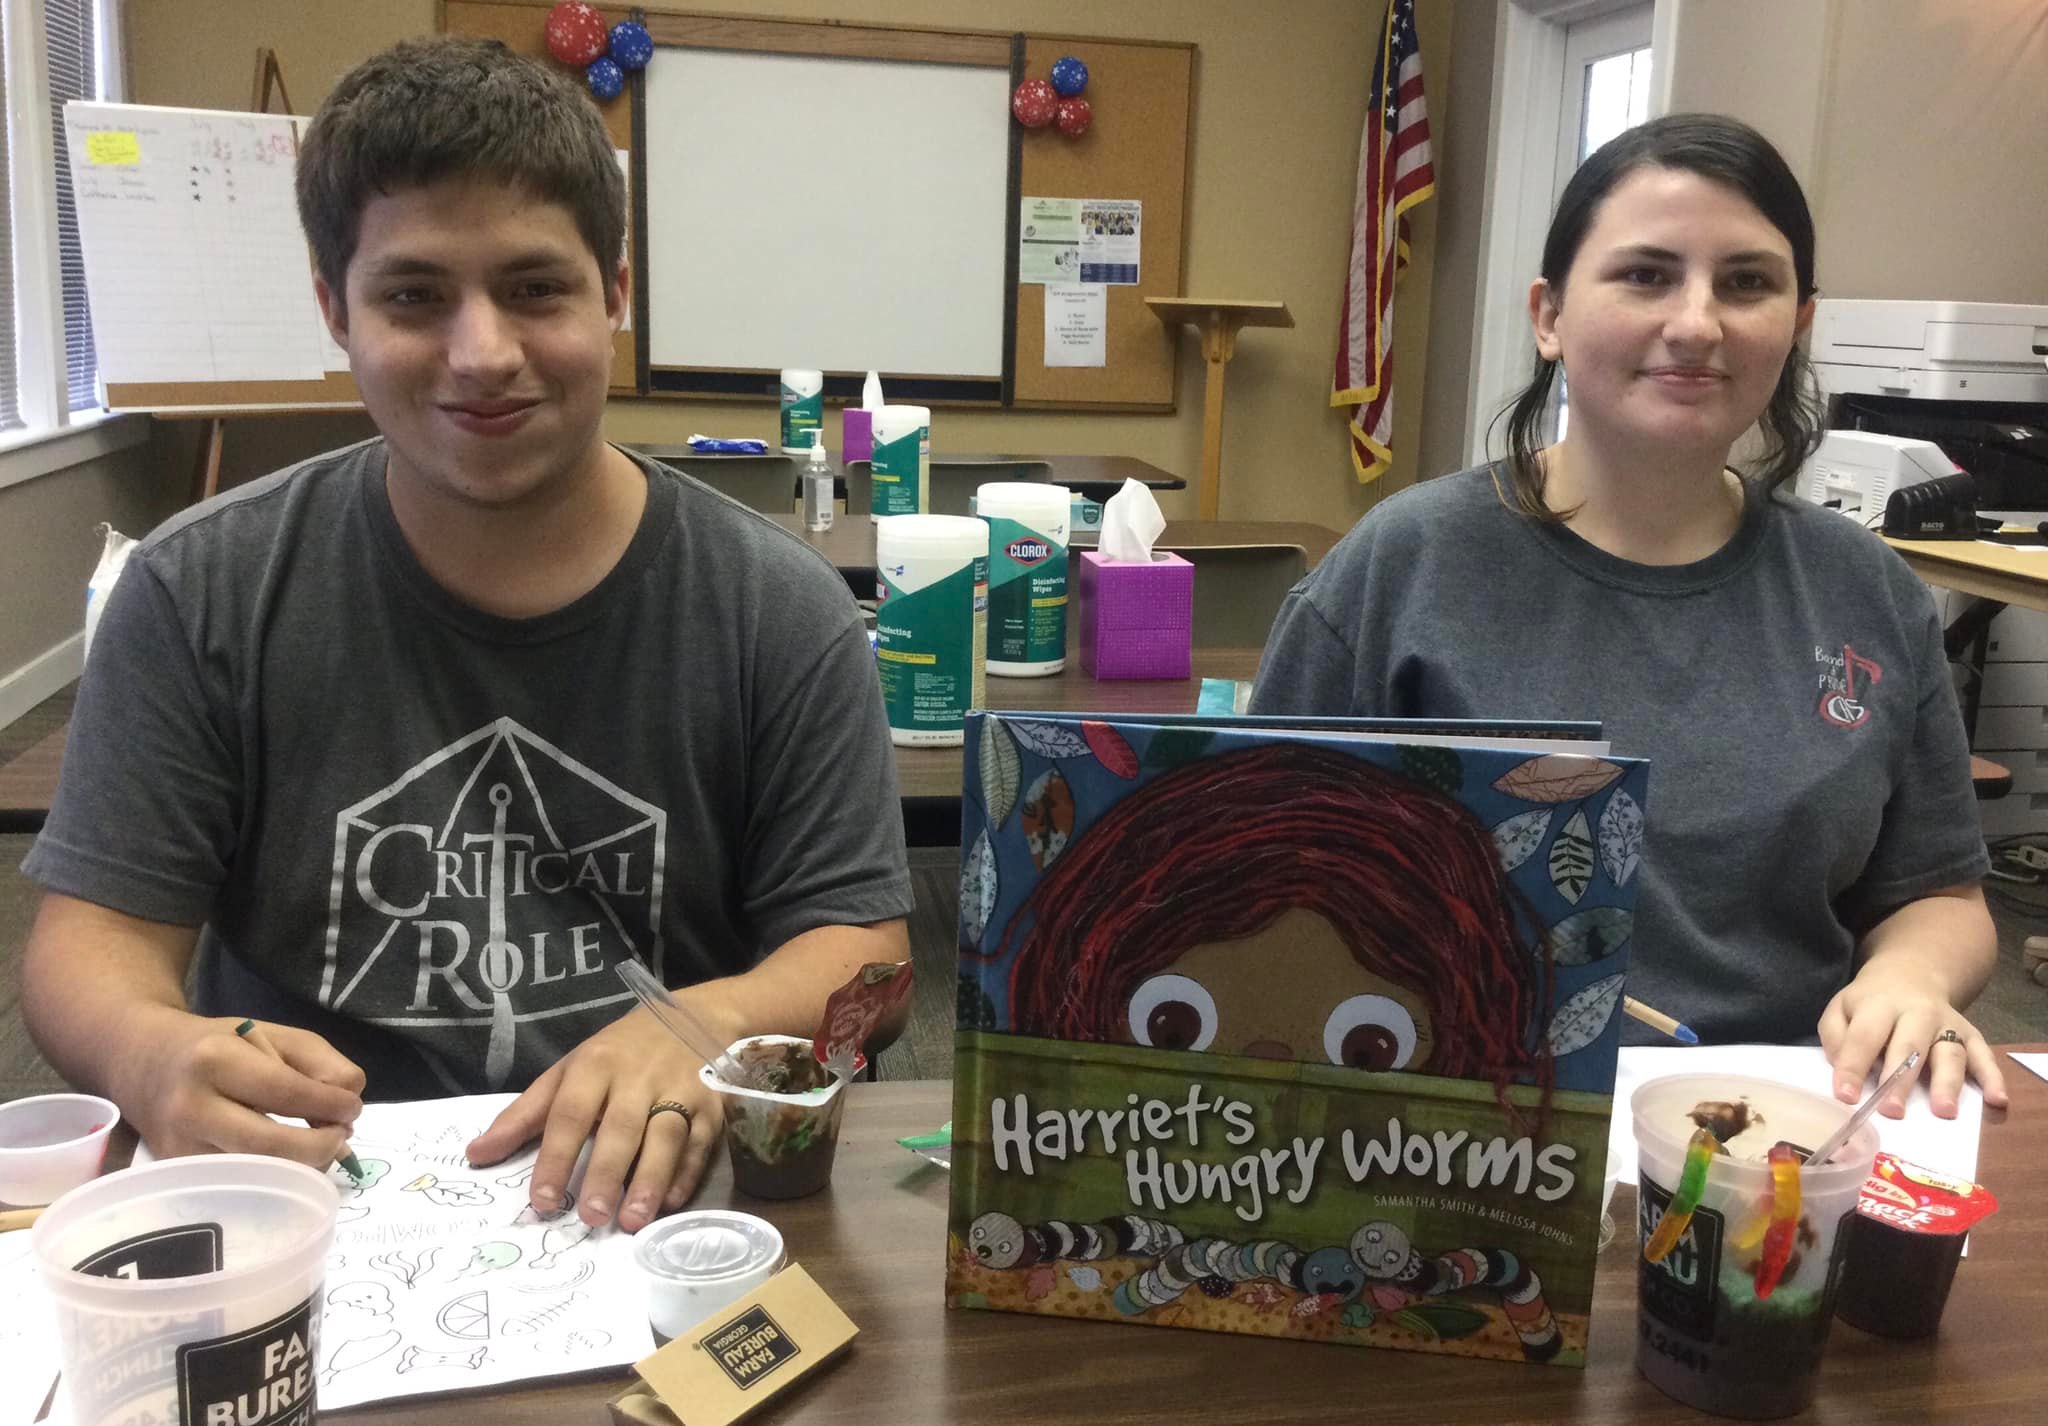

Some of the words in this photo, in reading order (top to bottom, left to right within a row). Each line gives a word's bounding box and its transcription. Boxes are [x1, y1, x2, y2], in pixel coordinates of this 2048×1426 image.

[1009, 544, 1048, 558] CLOROX
[1814, 645, 1844, 667] Band
[355, 823, 646, 918] CRITICAL
[405, 919, 604, 1012] ROLE
[991, 1084, 1255, 1175] Harriet's
[1125, 1136, 1325, 1222] Hungry
[1341, 1117, 1577, 1201] Worms
[1373, 1195, 1436, 1209] SAMANTHA
[1440, 1199, 1475, 1215] SMITH
[1478, 1206, 1486, 1217] &
[1489, 1208, 1536, 1231] MELISSA
[712, 1324, 749, 1350] GEORGIA
[723, 1325, 779, 1367] BUREAU
[733, 1346, 777, 1378] FARM
